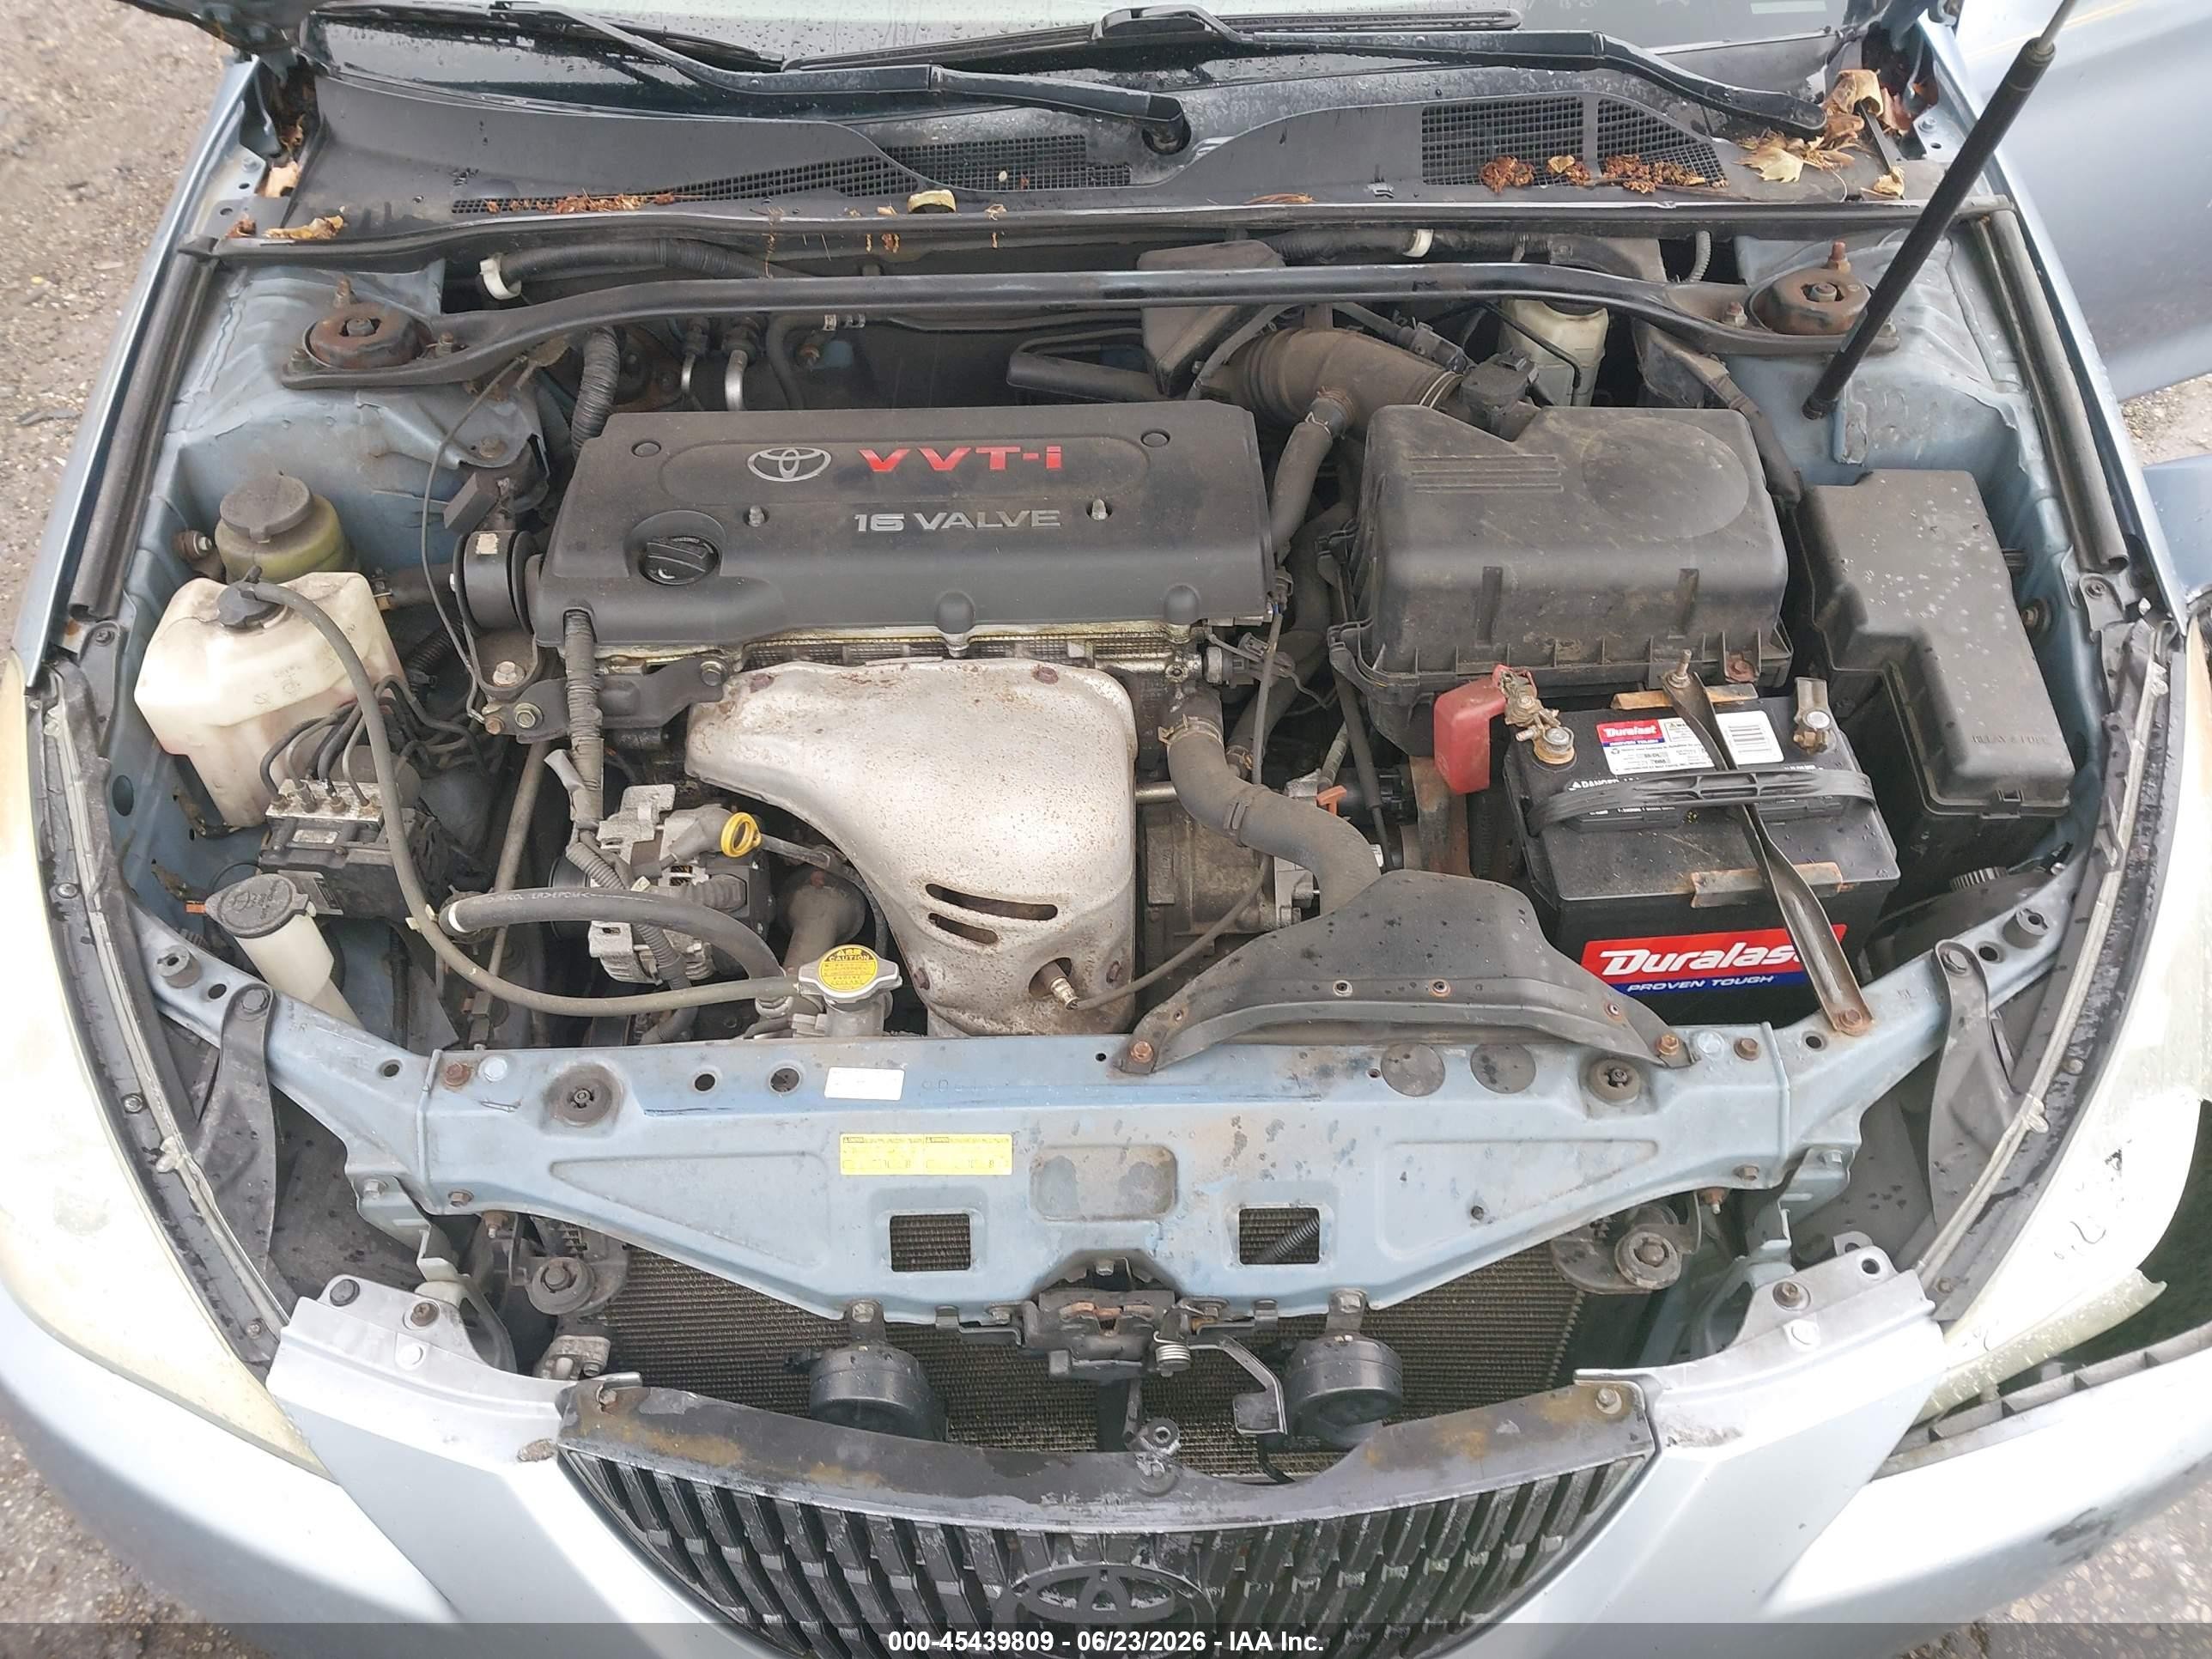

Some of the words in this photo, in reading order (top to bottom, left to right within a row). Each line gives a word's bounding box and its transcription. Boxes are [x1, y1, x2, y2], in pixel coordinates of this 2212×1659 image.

[858, 446, 1063, 472] VVT-i
[854, 513, 905, 532] 16
[913, 509, 1062, 531] VALVE
[1603, 725, 1657, 738] Duralast
[1599, 942, 1801, 976] Duralas
[1627, 980, 1706, 993] PROVEN
[1711, 975, 1774, 988] TOUGH
